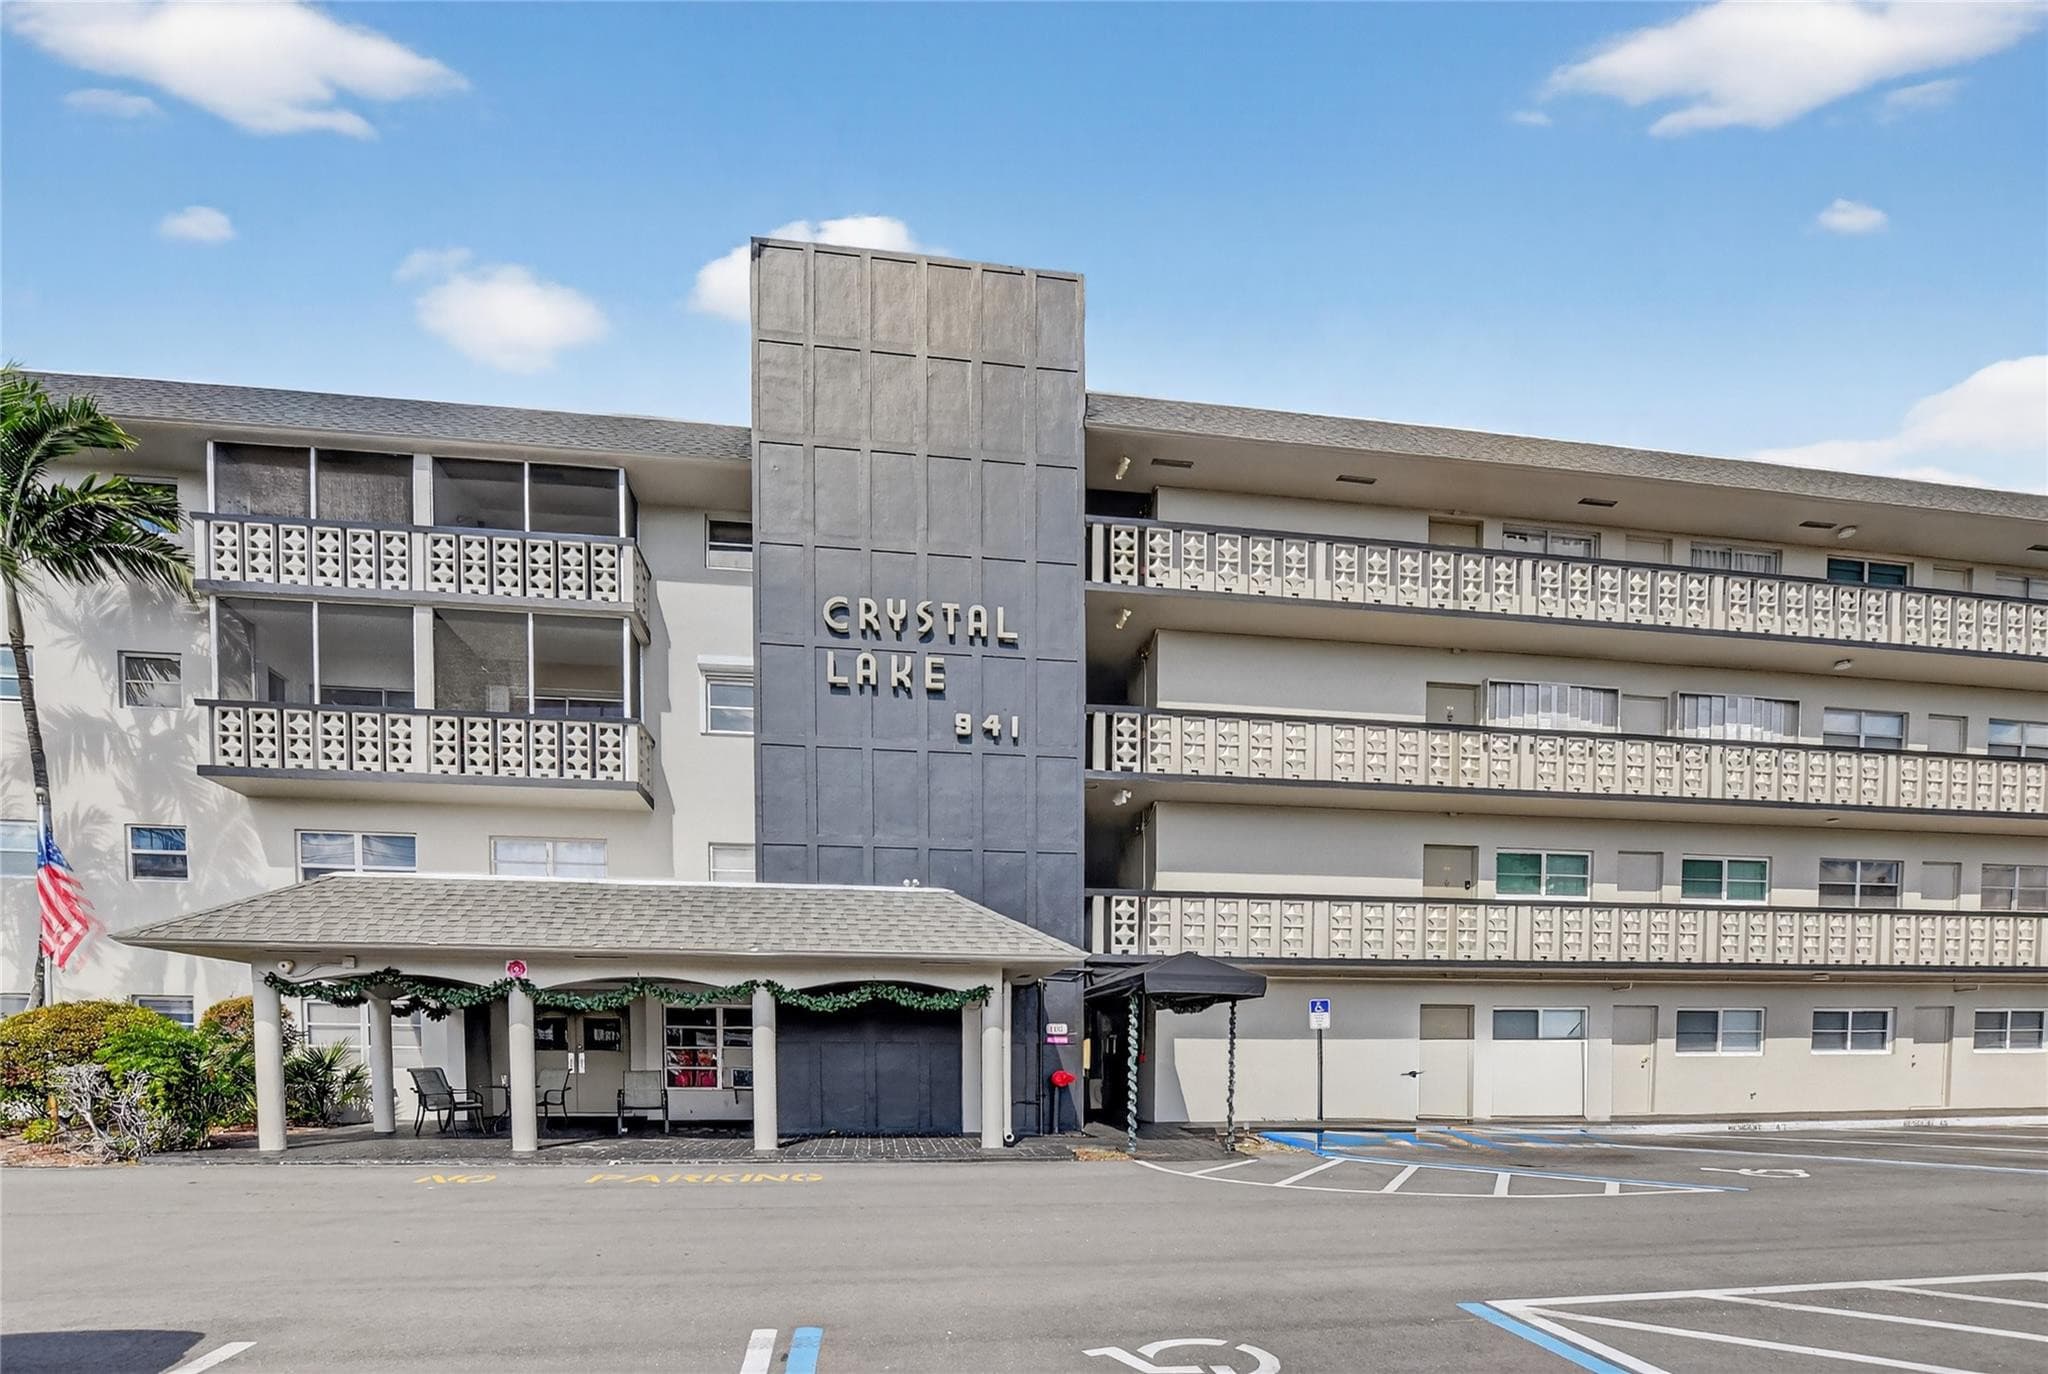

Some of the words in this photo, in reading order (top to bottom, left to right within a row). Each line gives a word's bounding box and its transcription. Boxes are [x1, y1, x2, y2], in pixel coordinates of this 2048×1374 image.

[823, 596, 1018, 641] CRYSTAL
[827, 651, 944, 690] LAKE
[955, 713, 1019, 738] 941
[413, 1174, 497, 1184] NO
[585, 1173, 824, 1184] PARKING
